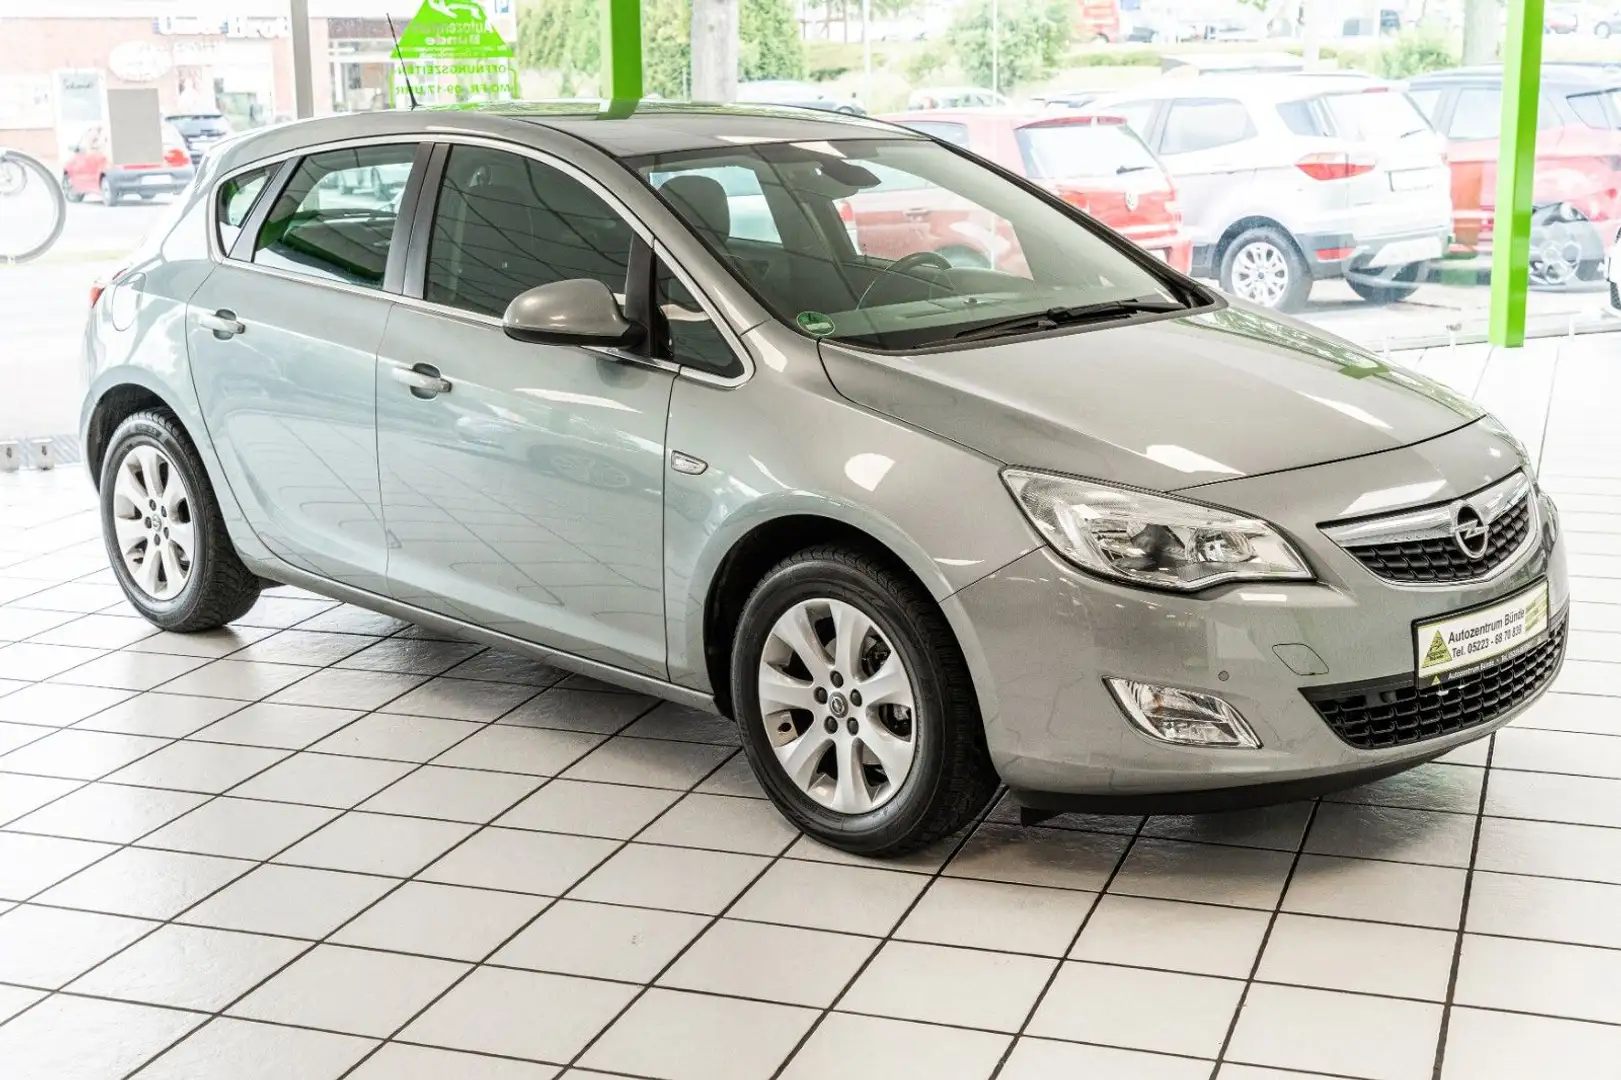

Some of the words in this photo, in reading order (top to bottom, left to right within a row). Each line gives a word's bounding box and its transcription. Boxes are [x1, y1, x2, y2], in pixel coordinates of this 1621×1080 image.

[1448, 620, 1502, 645] Autozentrum
[1504, 608, 1525, 627] Bünde
[1452, 647, 1466, 658] Tel.
[1467, 637, 1489, 655] 05223
